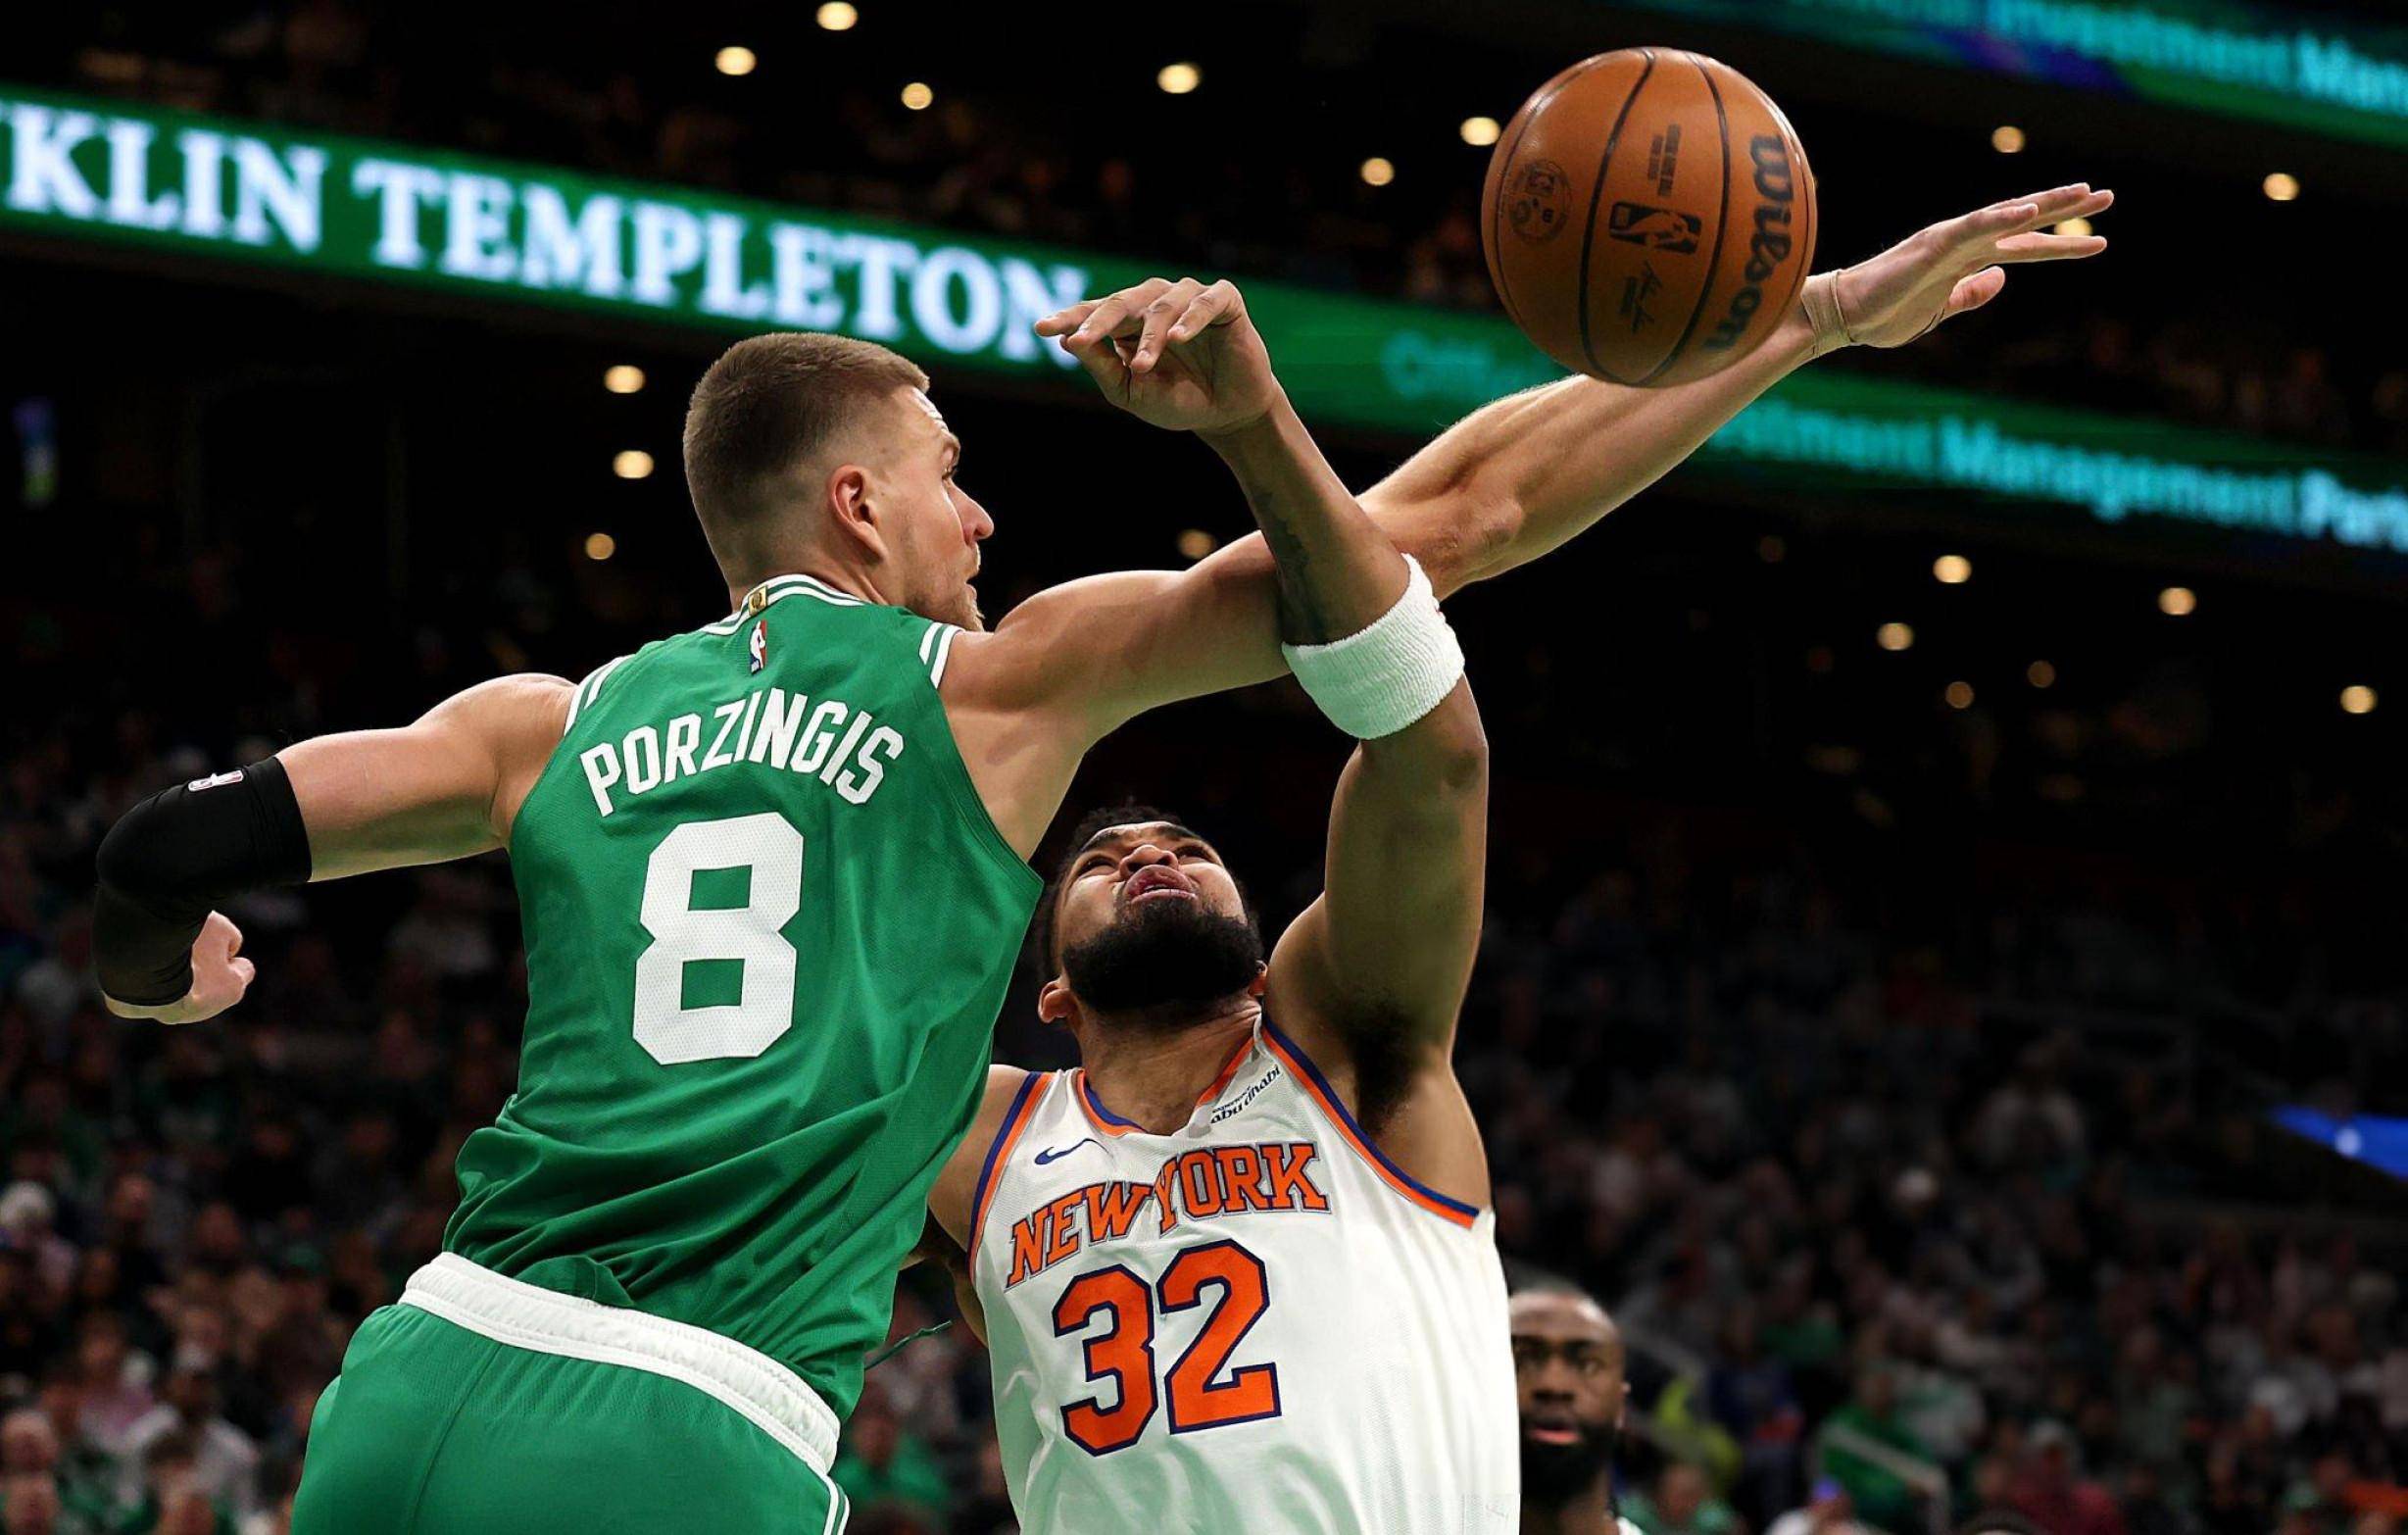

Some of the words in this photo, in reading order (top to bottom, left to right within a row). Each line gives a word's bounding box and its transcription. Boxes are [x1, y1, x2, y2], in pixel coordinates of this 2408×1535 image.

[0, 101, 327, 252] KLIN
[353, 157, 1089, 370] TEMPLETON
[1703, 131, 1794, 353] Wilson
[579, 686, 905, 817] PORZINGIS
[631, 811, 805, 1066] 8
[1006, 1179, 1155, 1292] NEW
[1153, 1142, 1332, 1238] YORK
[1209, 1103, 1243, 1124] abu
[1052, 1238, 1282, 1457] 32
